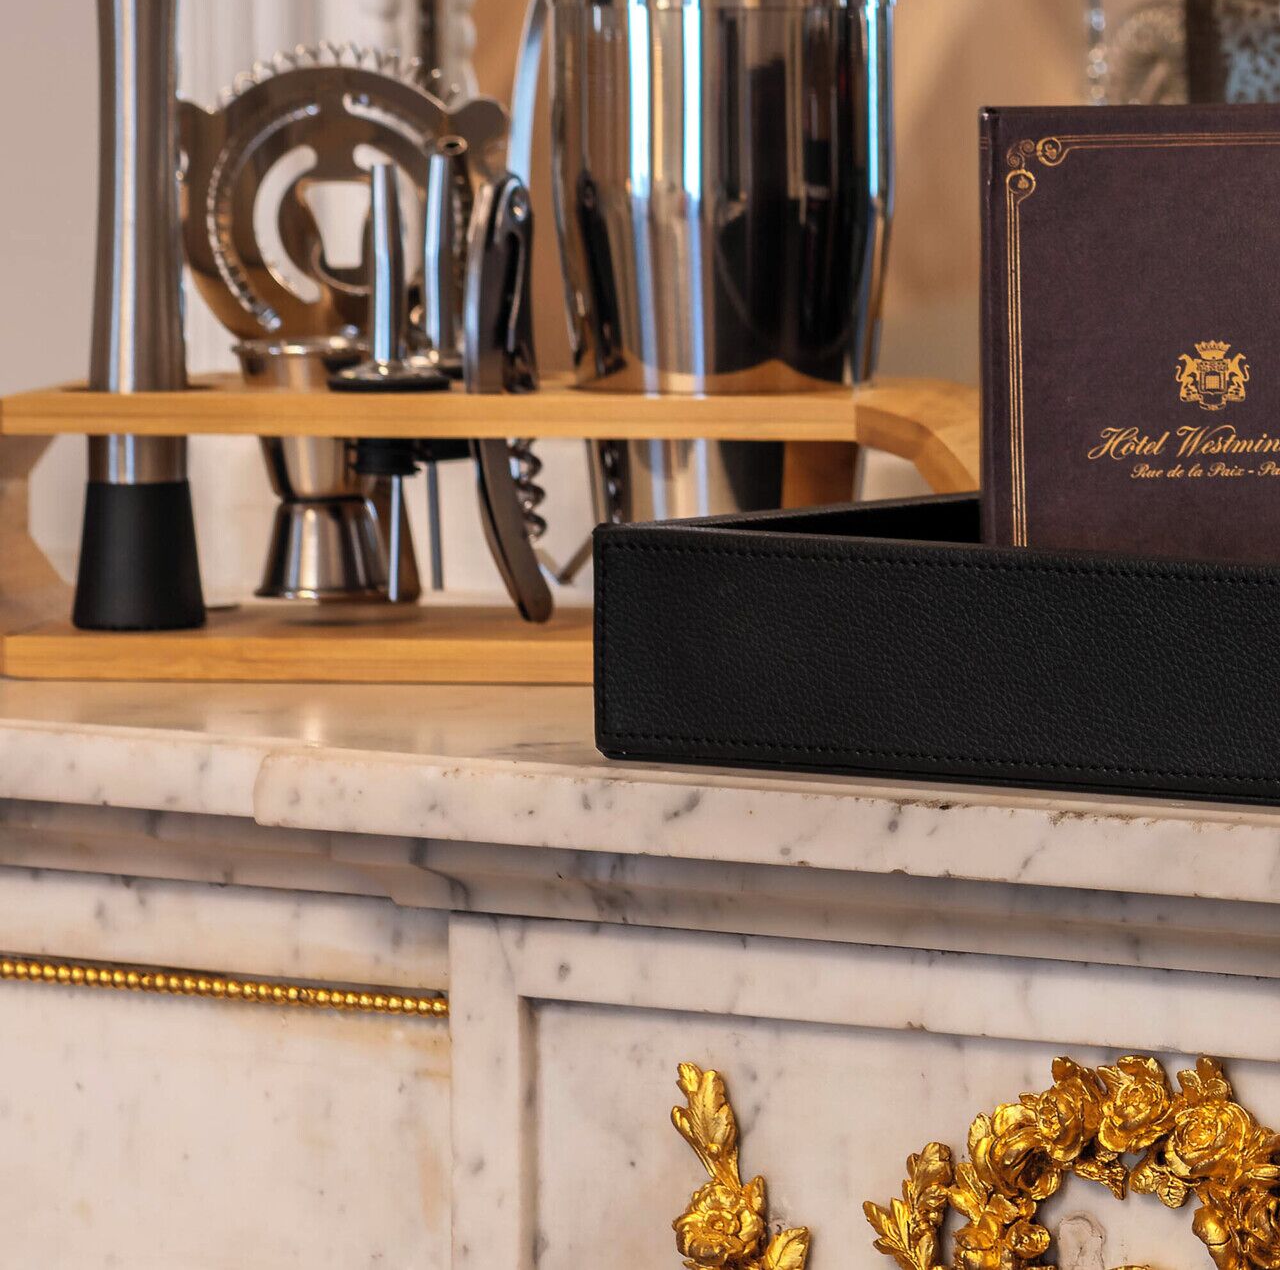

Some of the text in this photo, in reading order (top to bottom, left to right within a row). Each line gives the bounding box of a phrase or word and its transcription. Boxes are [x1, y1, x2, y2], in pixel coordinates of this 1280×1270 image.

[1087, 426, 1170, 460] Hôtel
[1130, 462, 1163, 479] Rue
[1166, 463, 1184, 479] de
[1187, 463, 1203, 478] la
[1207, 461, 1244, 478] Paix
